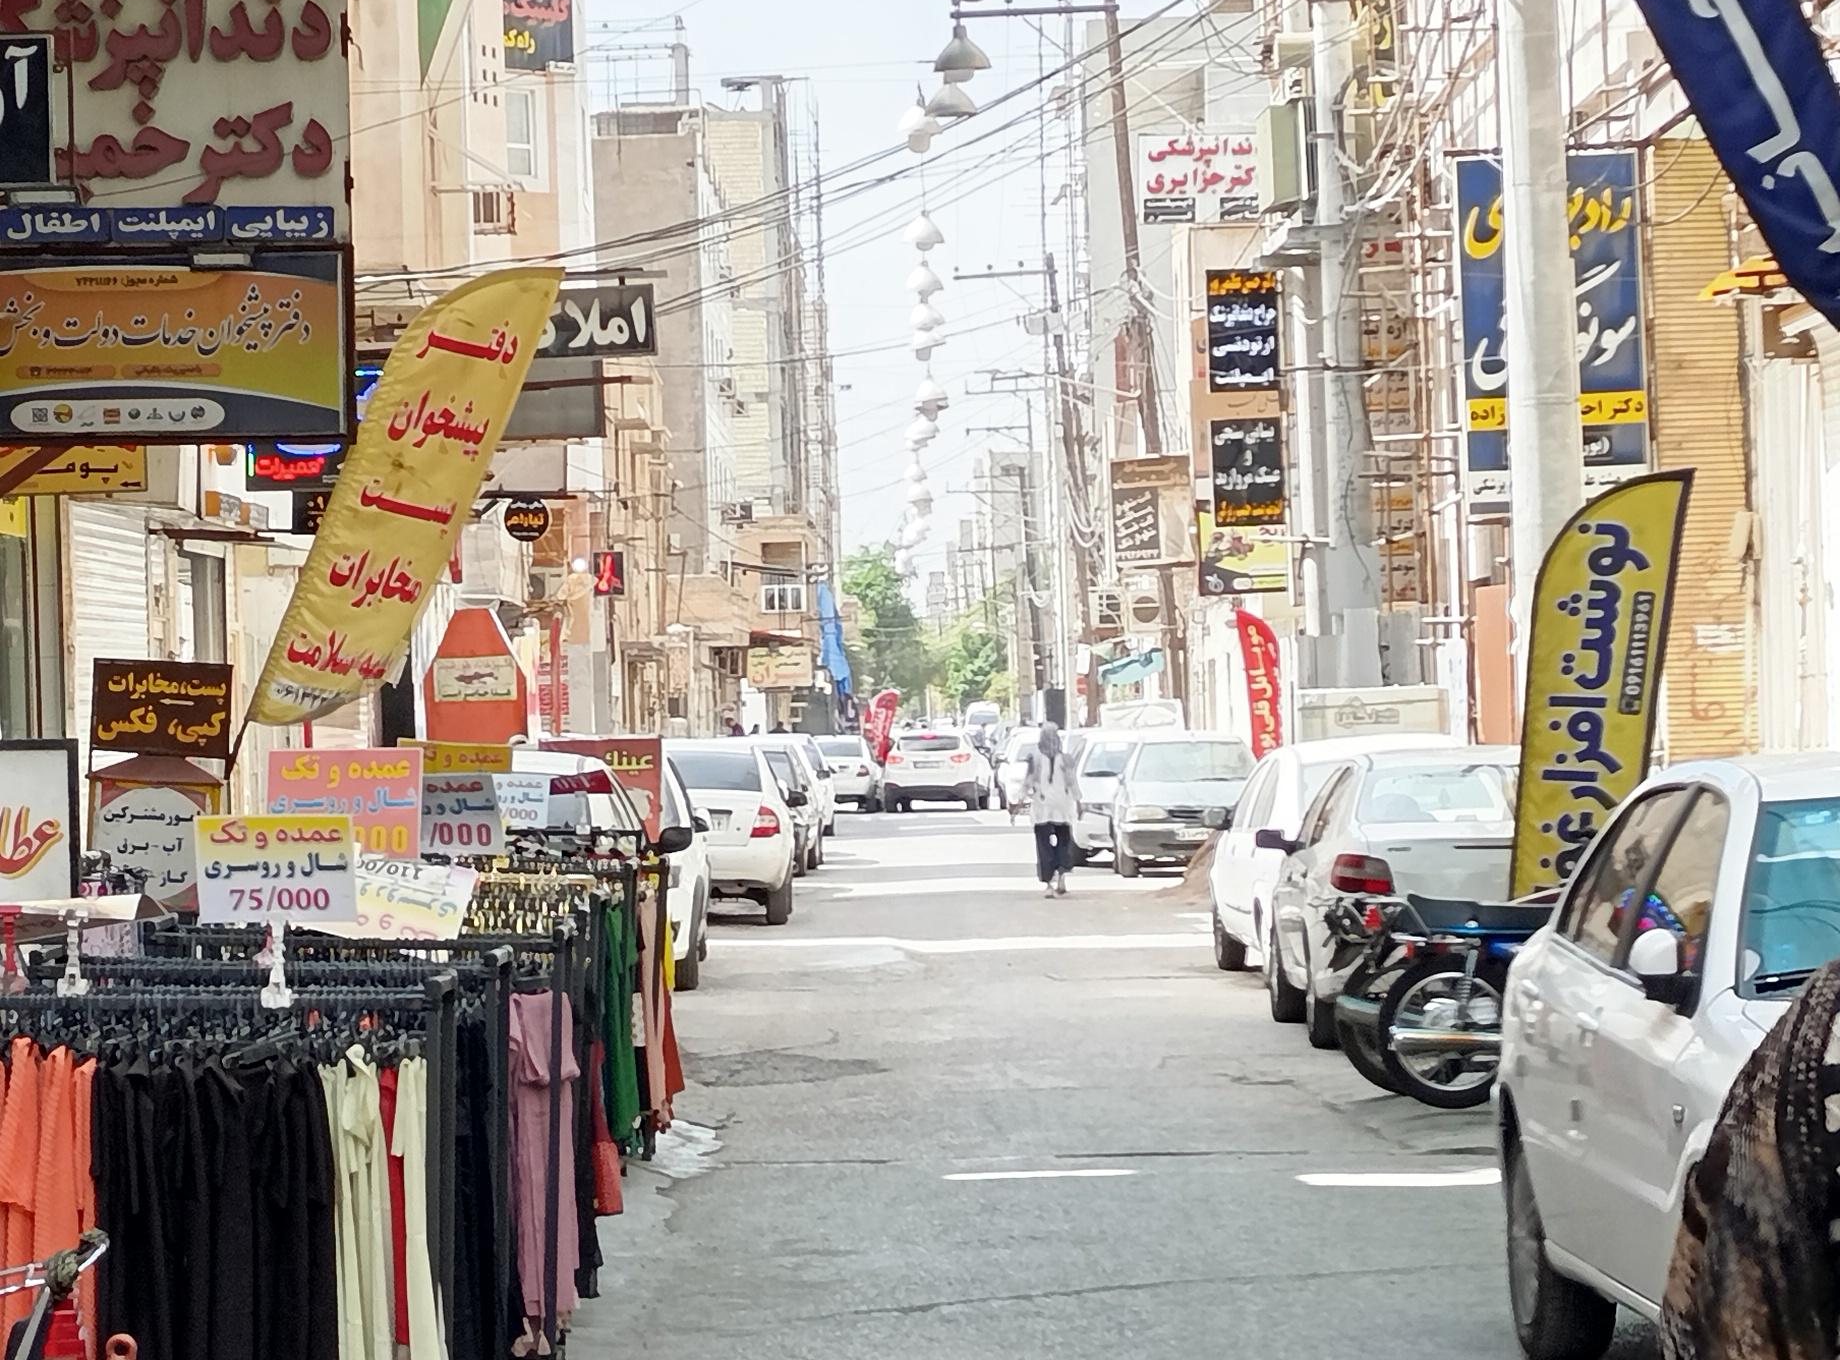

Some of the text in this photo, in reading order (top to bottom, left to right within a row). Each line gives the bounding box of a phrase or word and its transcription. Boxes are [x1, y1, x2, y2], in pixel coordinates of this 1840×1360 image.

[182, 100, 333, 205] دکتر
[1148, 132, 1258, 168] ندانپزشکی
[1146, 164, 1257, 195] کتر جزایری
[7, 209, 329, 240] زیبایی ایمپلنت اطفال
[53, 308, 120, 348] دولت
[121, 308, 198, 348] خدمات
[196, 285, 272, 357] پیشخوان
[268, 289, 311, 347] دفتر
[416, 320, 519, 365] دفتر
[1608, 397, 1644, 420] دکتر
[388, 389, 490, 463] پیشخوان
[360, 479, 457, 536] پست
[329, 549, 423, 609] مخابرات
[1556, 521, 1652, 690] نوشت
[98, 705, 159, 741] فکس
[1541, 695, 1623, 810] افزار
[281, 754, 411, 789] عمده و تک
[426, 781, 484, 794] عمده
[104, 806, 165, 824] مشترکین
[269, 796, 348, 814] روسری
[353, 796, 363, 814] و
[368, 786, 418, 813] شال
[449, 798, 495, 815] شال
[117, 838, 149, 855] برق
[162, 837, 184, 856] آب
[210, 819, 344, 850] عمده و تک
[204, 851, 348, 880] شال و روسری
[229, 886, 330, 912] 75/000
